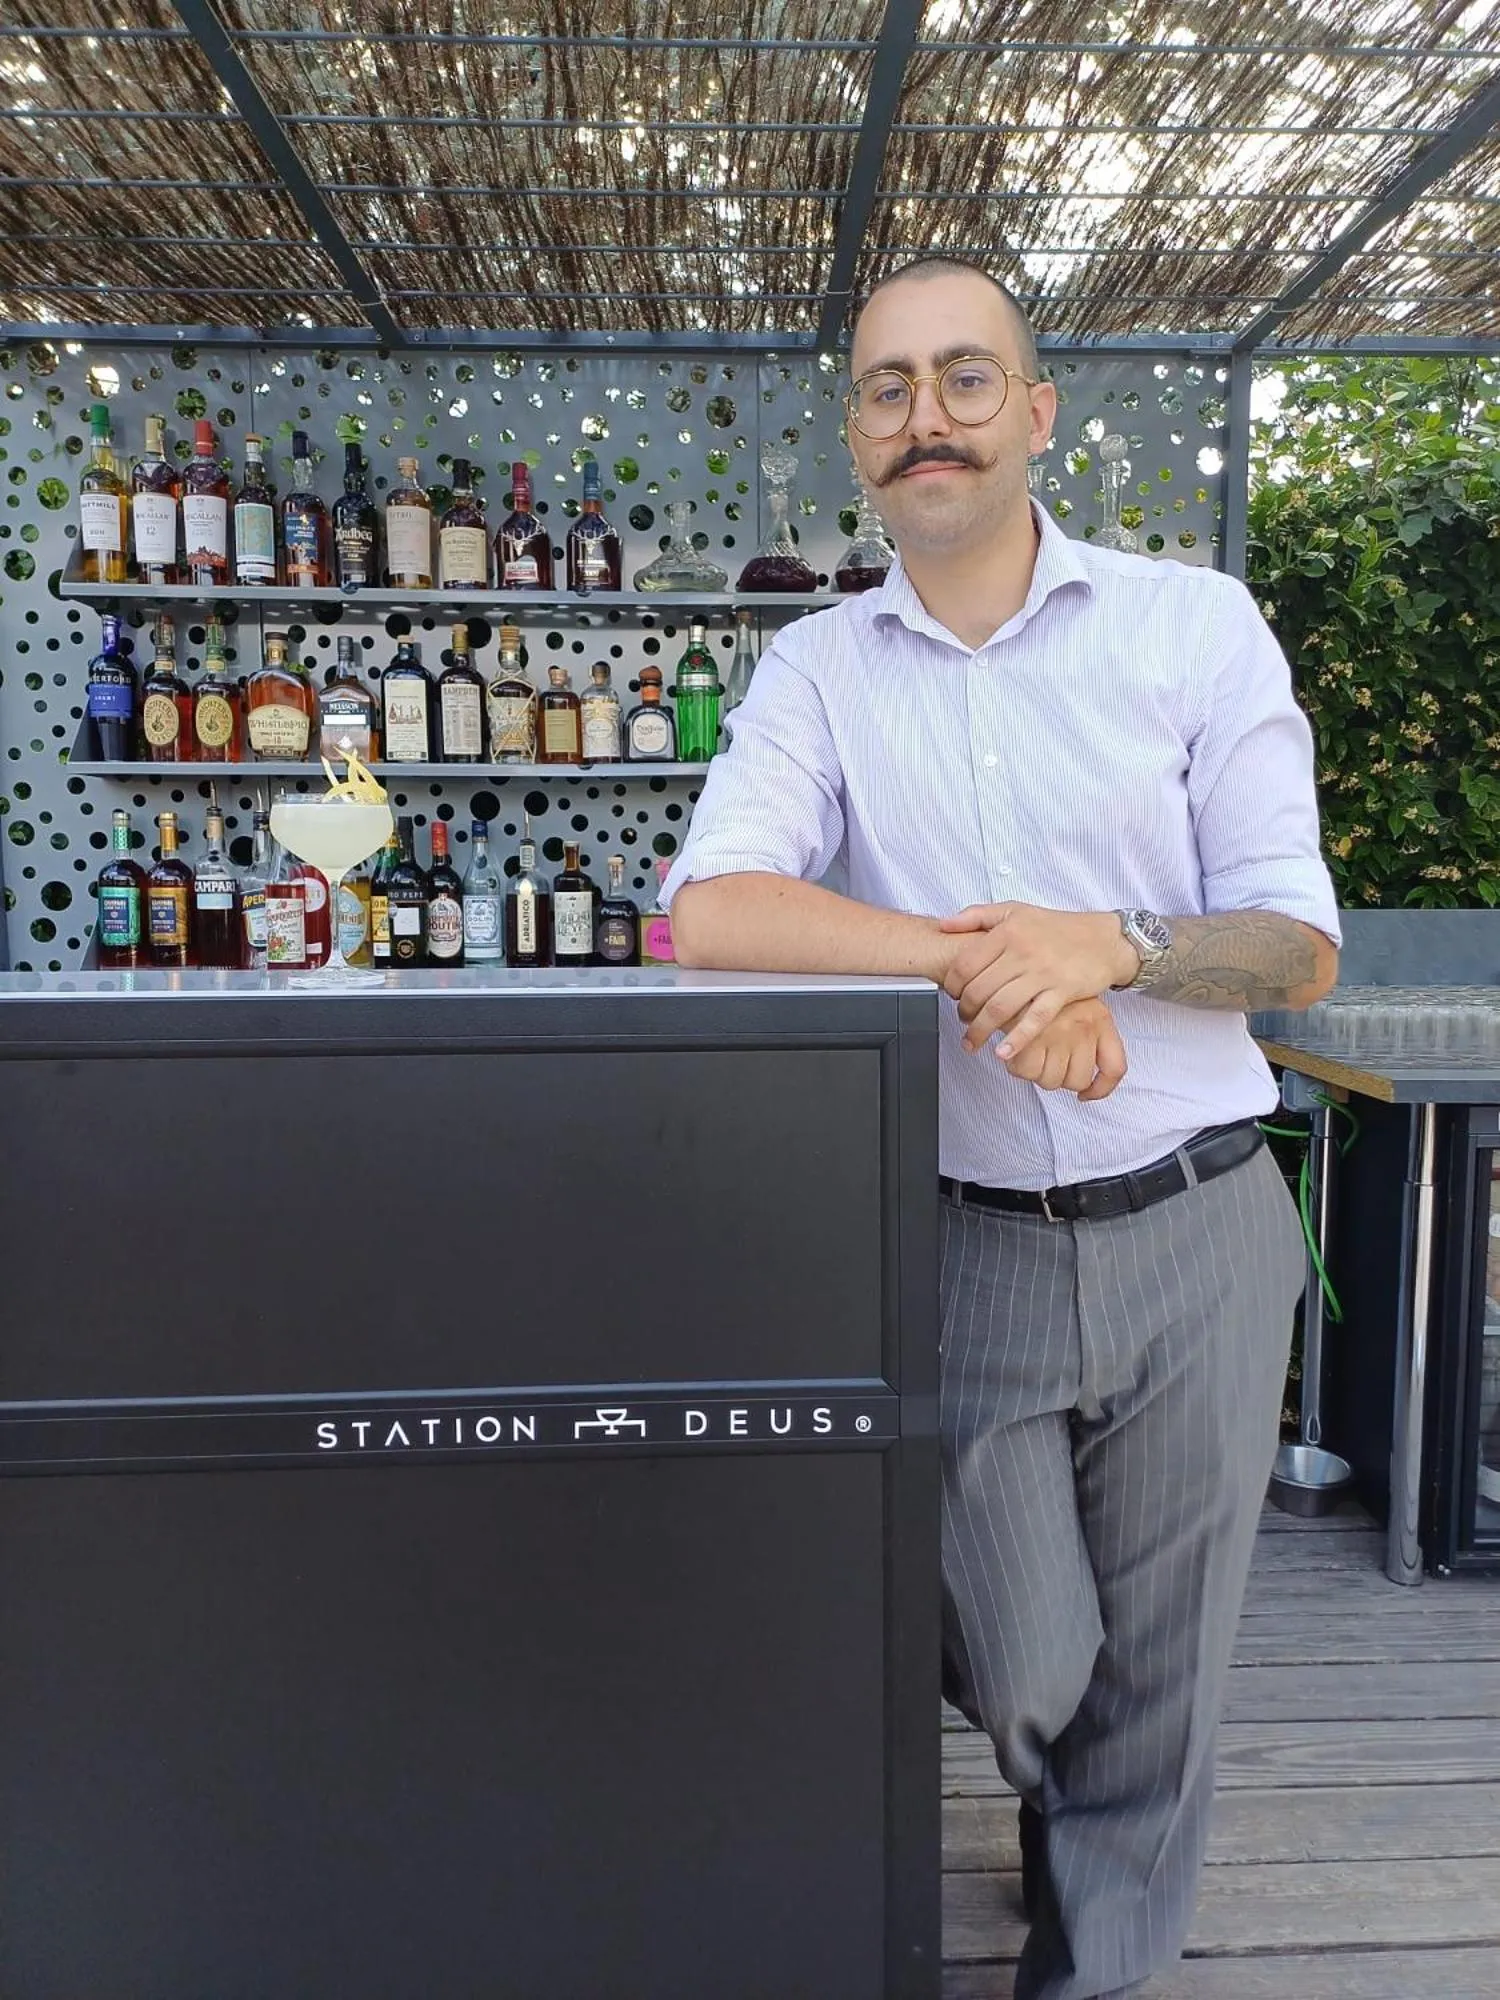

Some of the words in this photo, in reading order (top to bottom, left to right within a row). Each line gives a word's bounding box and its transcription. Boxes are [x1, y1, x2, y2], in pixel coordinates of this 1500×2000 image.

[335, 526, 373, 543] Ardbeg
[194, 880, 237, 893] CAMPARI
[242, 895, 266, 909] APER
[522, 899, 531, 943] ADRIATICO
[316, 1414, 536, 1449] STATION
[684, 1406, 833, 1437] DEUS
